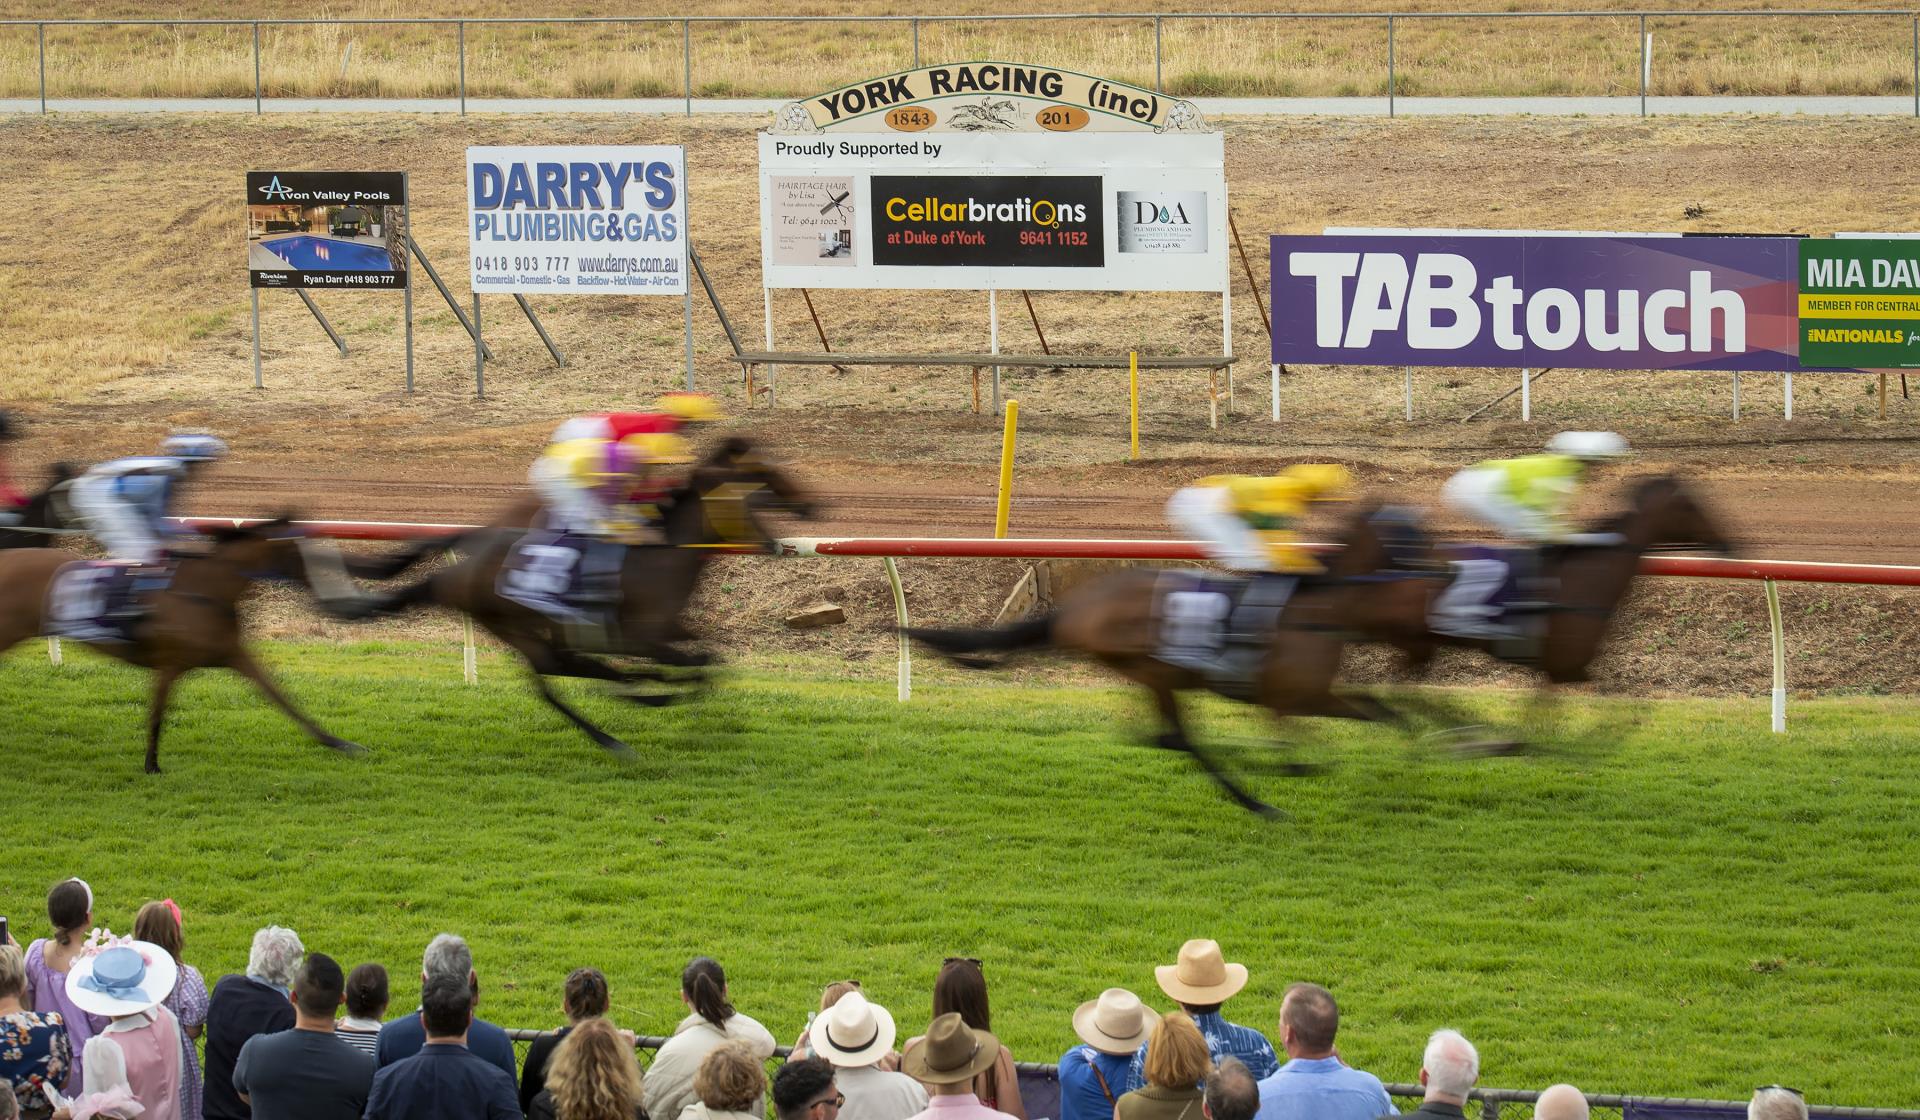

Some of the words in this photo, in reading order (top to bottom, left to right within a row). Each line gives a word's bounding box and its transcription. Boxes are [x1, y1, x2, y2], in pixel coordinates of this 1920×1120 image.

[818, 75, 915, 120] YORK
[929, 65, 1063, 98] RACING
[1088, 80, 1158, 122] (inc)
[892, 112, 930, 125] 1843
[776, 142, 835, 158] Proudly
[839, 141, 918, 157] Supported
[923, 142, 942, 158] by
[473, 161, 676, 211] DARRY'S
[777, 182, 824, 190] HAIRITAGE
[825, 182, 847, 190] HAIR
[313, 191, 350, 201] Valley
[354, 191, 390, 200] Pools
[788, 191, 798, 199] by
[799, 191, 815, 199] Lisa
[475, 213, 678, 242] PLUMBING&GAS
[781, 216, 798, 225] Tel:
[887, 231, 900, 245] at
[904, 231, 937, 245] Duke
[941, 231, 958, 245] of
[958, 231, 986, 245] York
[1020, 231, 1052, 246] 9641
[1058, 231, 1088, 246] 1152
[476, 256, 508, 271] 0418
[515, 256, 538, 271] 903
[546, 256, 570, 271] 777
[578, 253, 679, 275] www.darrys.com.au
[303, 275, 324, 285] Ryan
[326, 275, 343, 283] Darr
[345, 275, 363, 284] 0418
[365, 275, 379, 284] 903
[381, 275, 395, 284] 777
[476, 275, 515, 285] Commercial
[520, 275, 552, 285] Domestic
[557, 276, 570, 285] Gas
[1807, 258, 1866, 288] MIA
[577, 275, 610, 286] Backflow
[652, 276, 663, 286] Air
[664, 276, 679, 286] Con
[1288, 252, 1746, 353] TABtouch
[1808, 300, 1852, 311] MEMBER
[1854, 301, 1874, 311] FOR
[1876, 301, 1920, 312] CENTRAL
[1813, 329, 1904, 343] NATIONALS
